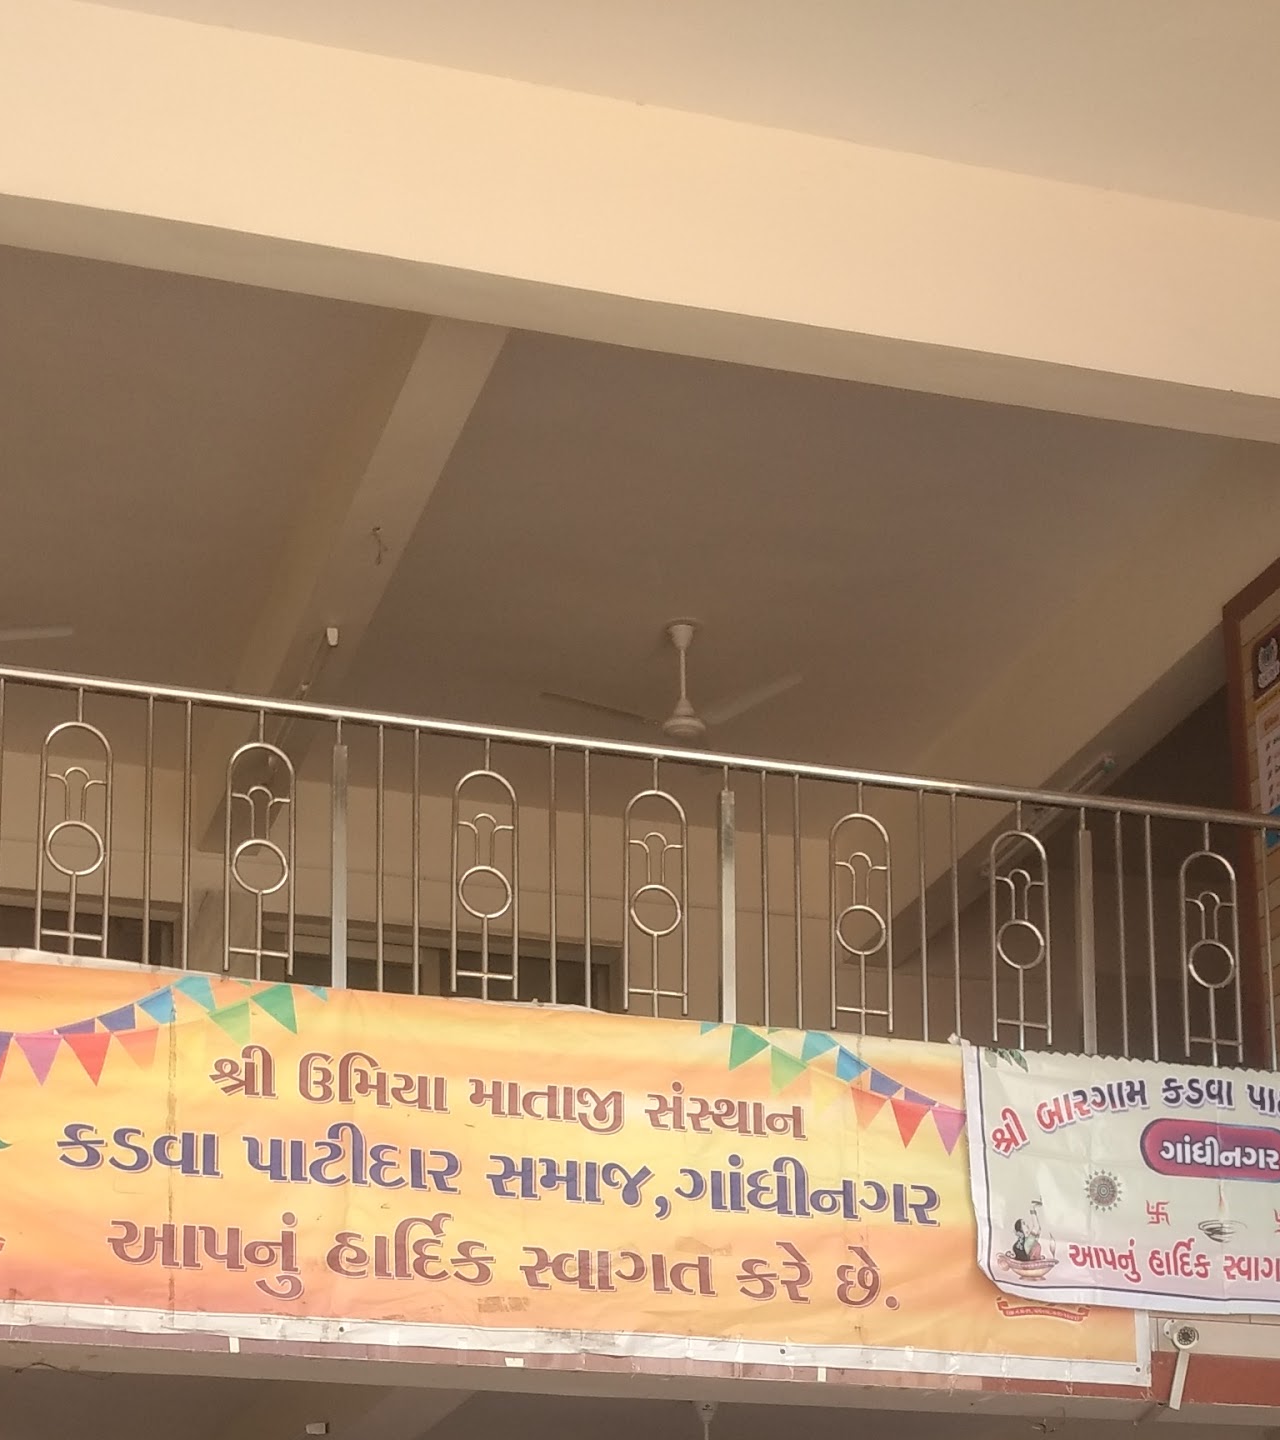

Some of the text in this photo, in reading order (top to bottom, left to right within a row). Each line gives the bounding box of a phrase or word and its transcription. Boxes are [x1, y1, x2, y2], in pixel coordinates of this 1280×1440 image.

[208, 1044, 807, 1141] શ્રી ઉમિયા માતાજી સંસ્થાન
[991, 1106, 1030, 1159] શ્રી
[1036, 1076, 1149, 1134] બારગામ
[1161, 1076, 1235, 1109] કડવા
[56, 1123, 222, 1178] કડવા
[242, 1120, 463, 1195] પાટીદાર
[107, 1212, 901, 1311] આપનું હાર્દિક સ્વાગત કરે છે.
[1067, 1238, 1143, 1284] આપનું
[1148, 1231, 1212, 1281] હાર્દિક
